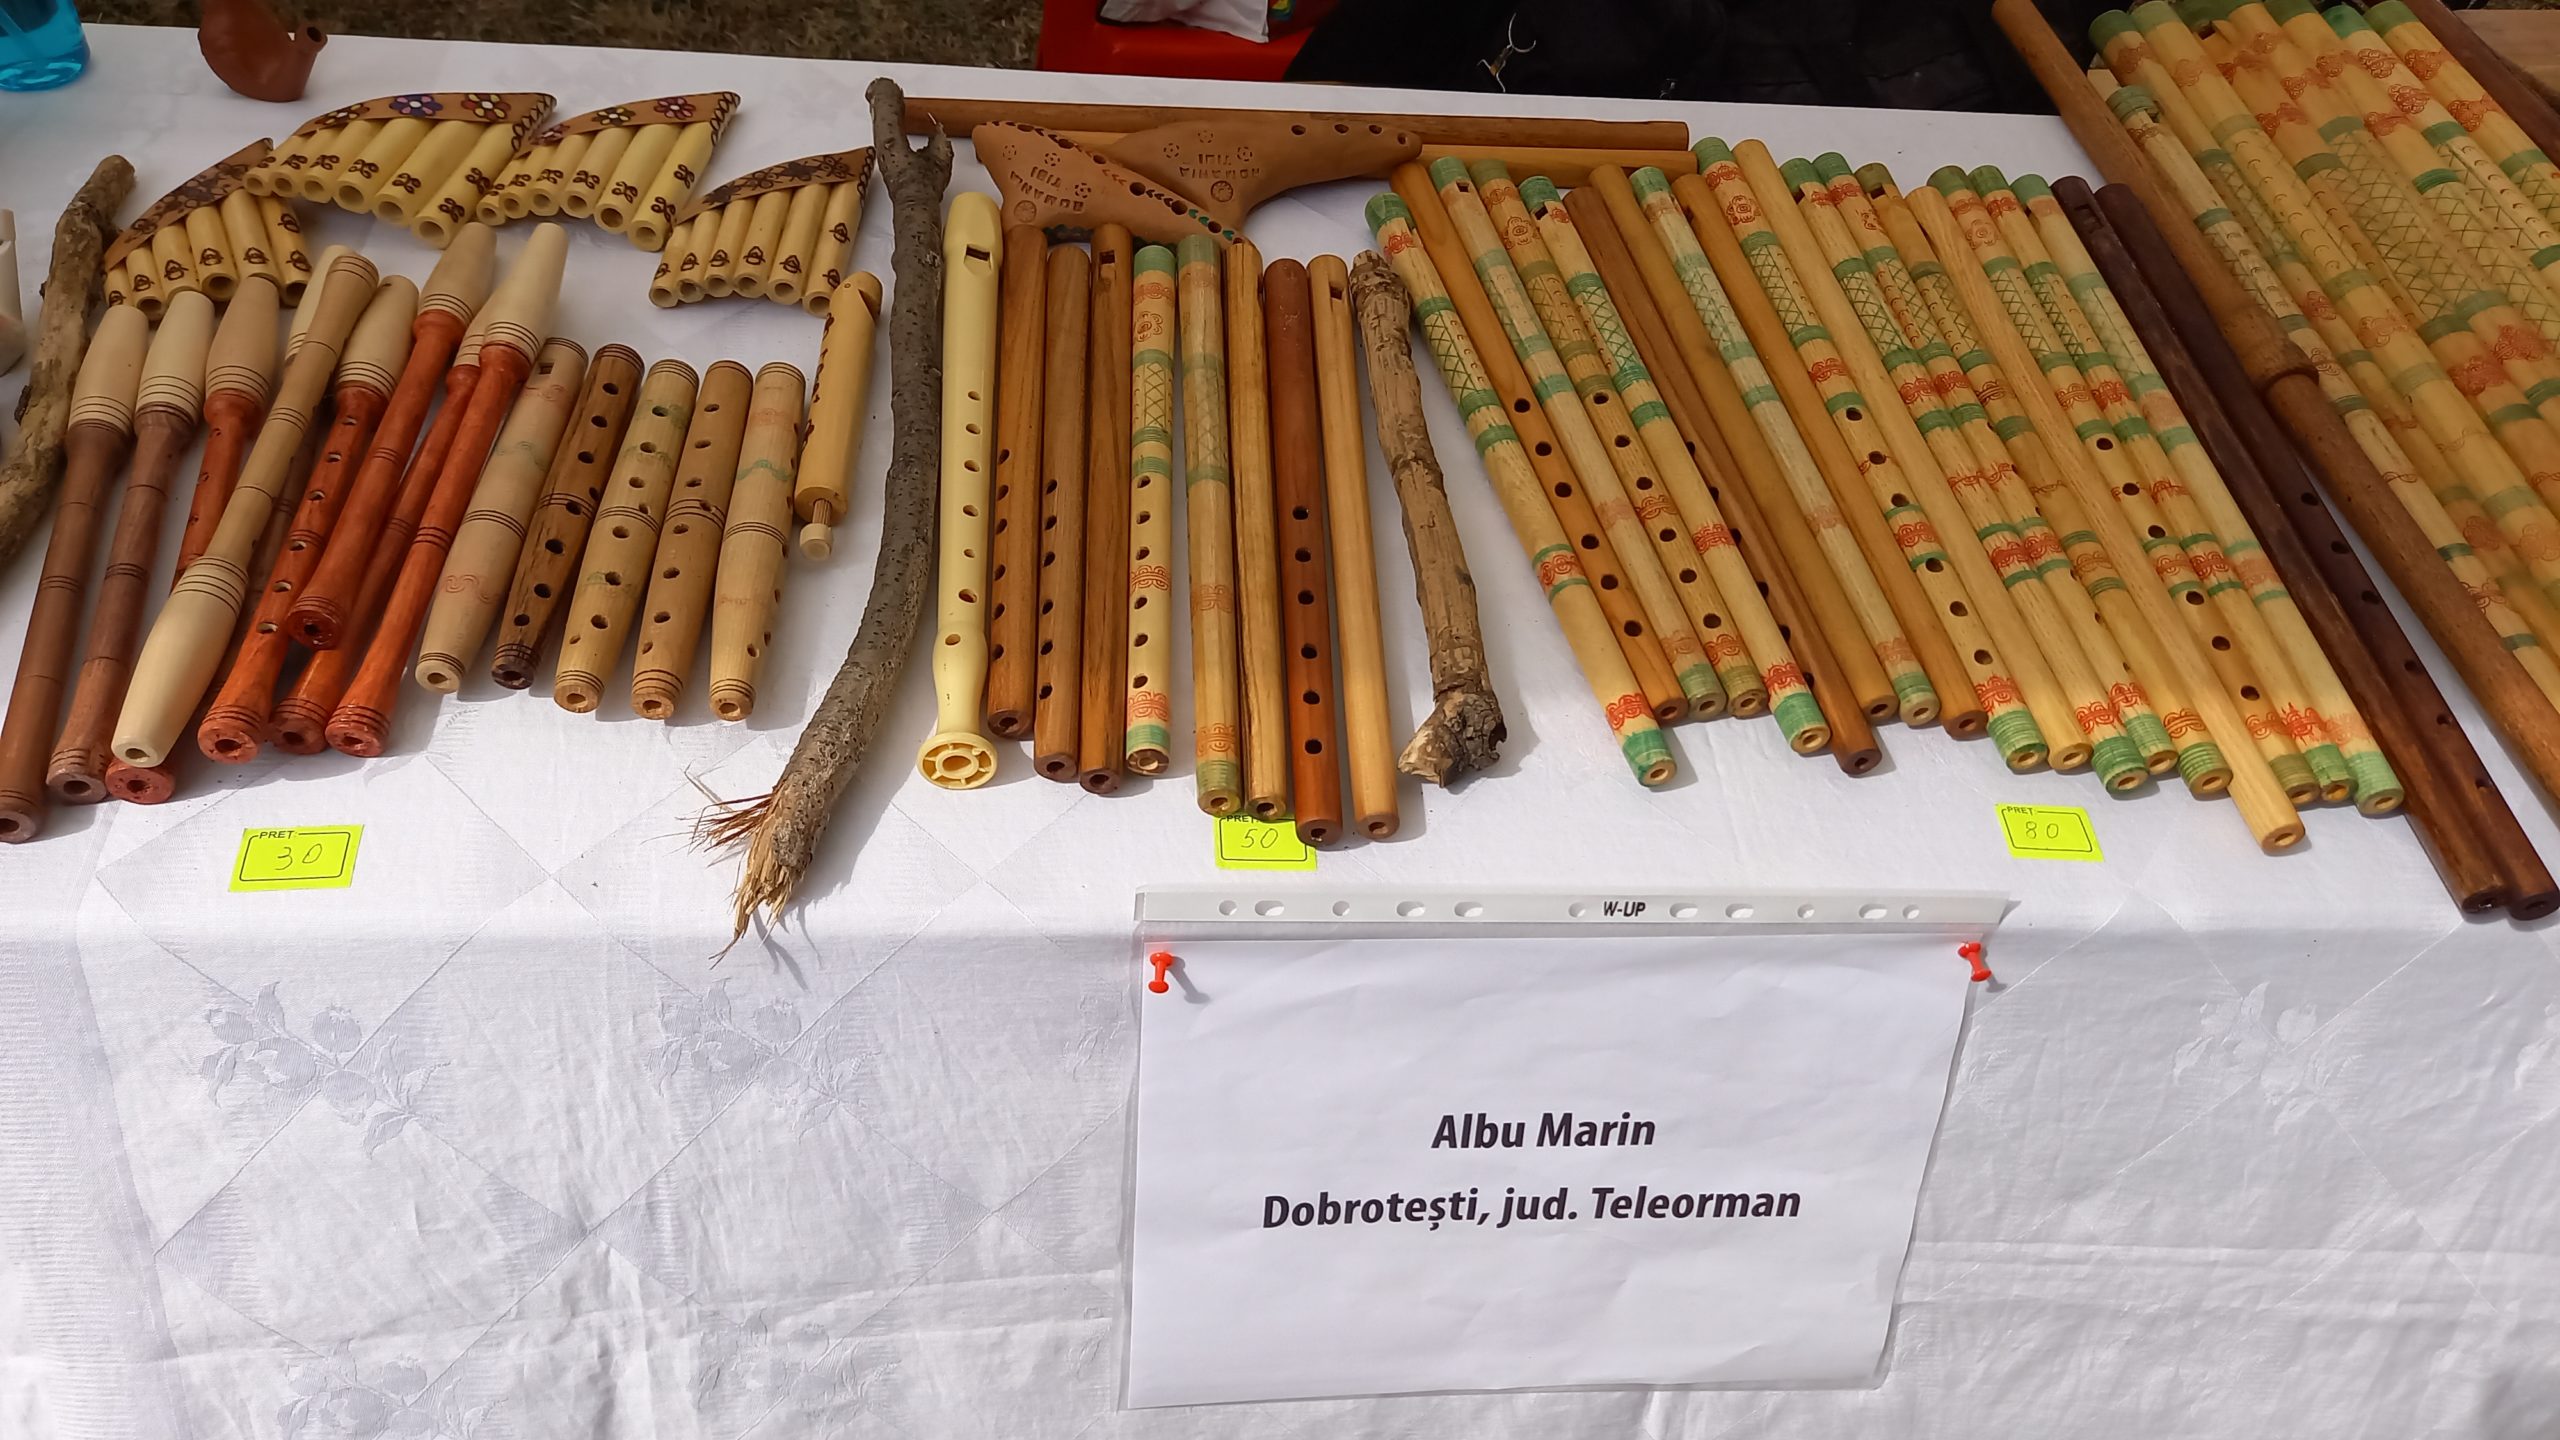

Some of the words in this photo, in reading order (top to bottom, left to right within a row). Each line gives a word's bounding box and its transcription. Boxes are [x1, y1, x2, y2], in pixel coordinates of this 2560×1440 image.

[1241, 828, 1279, 849] 50
[2025, 821, 2059, 840] 80
[274, 843, 323, 871] 30
[1603, 900, 1646, 917] W-UP
[1431, 1112, 1524, 1149] Albu
[1536, 1111, 1656, 1147] Marin
[1263, 1187, 1490, 1231] Dobrotești,
[1496, 1187, 1578, 1229] jud.
[1591, 1185, 1801, 1220] Teleorman
